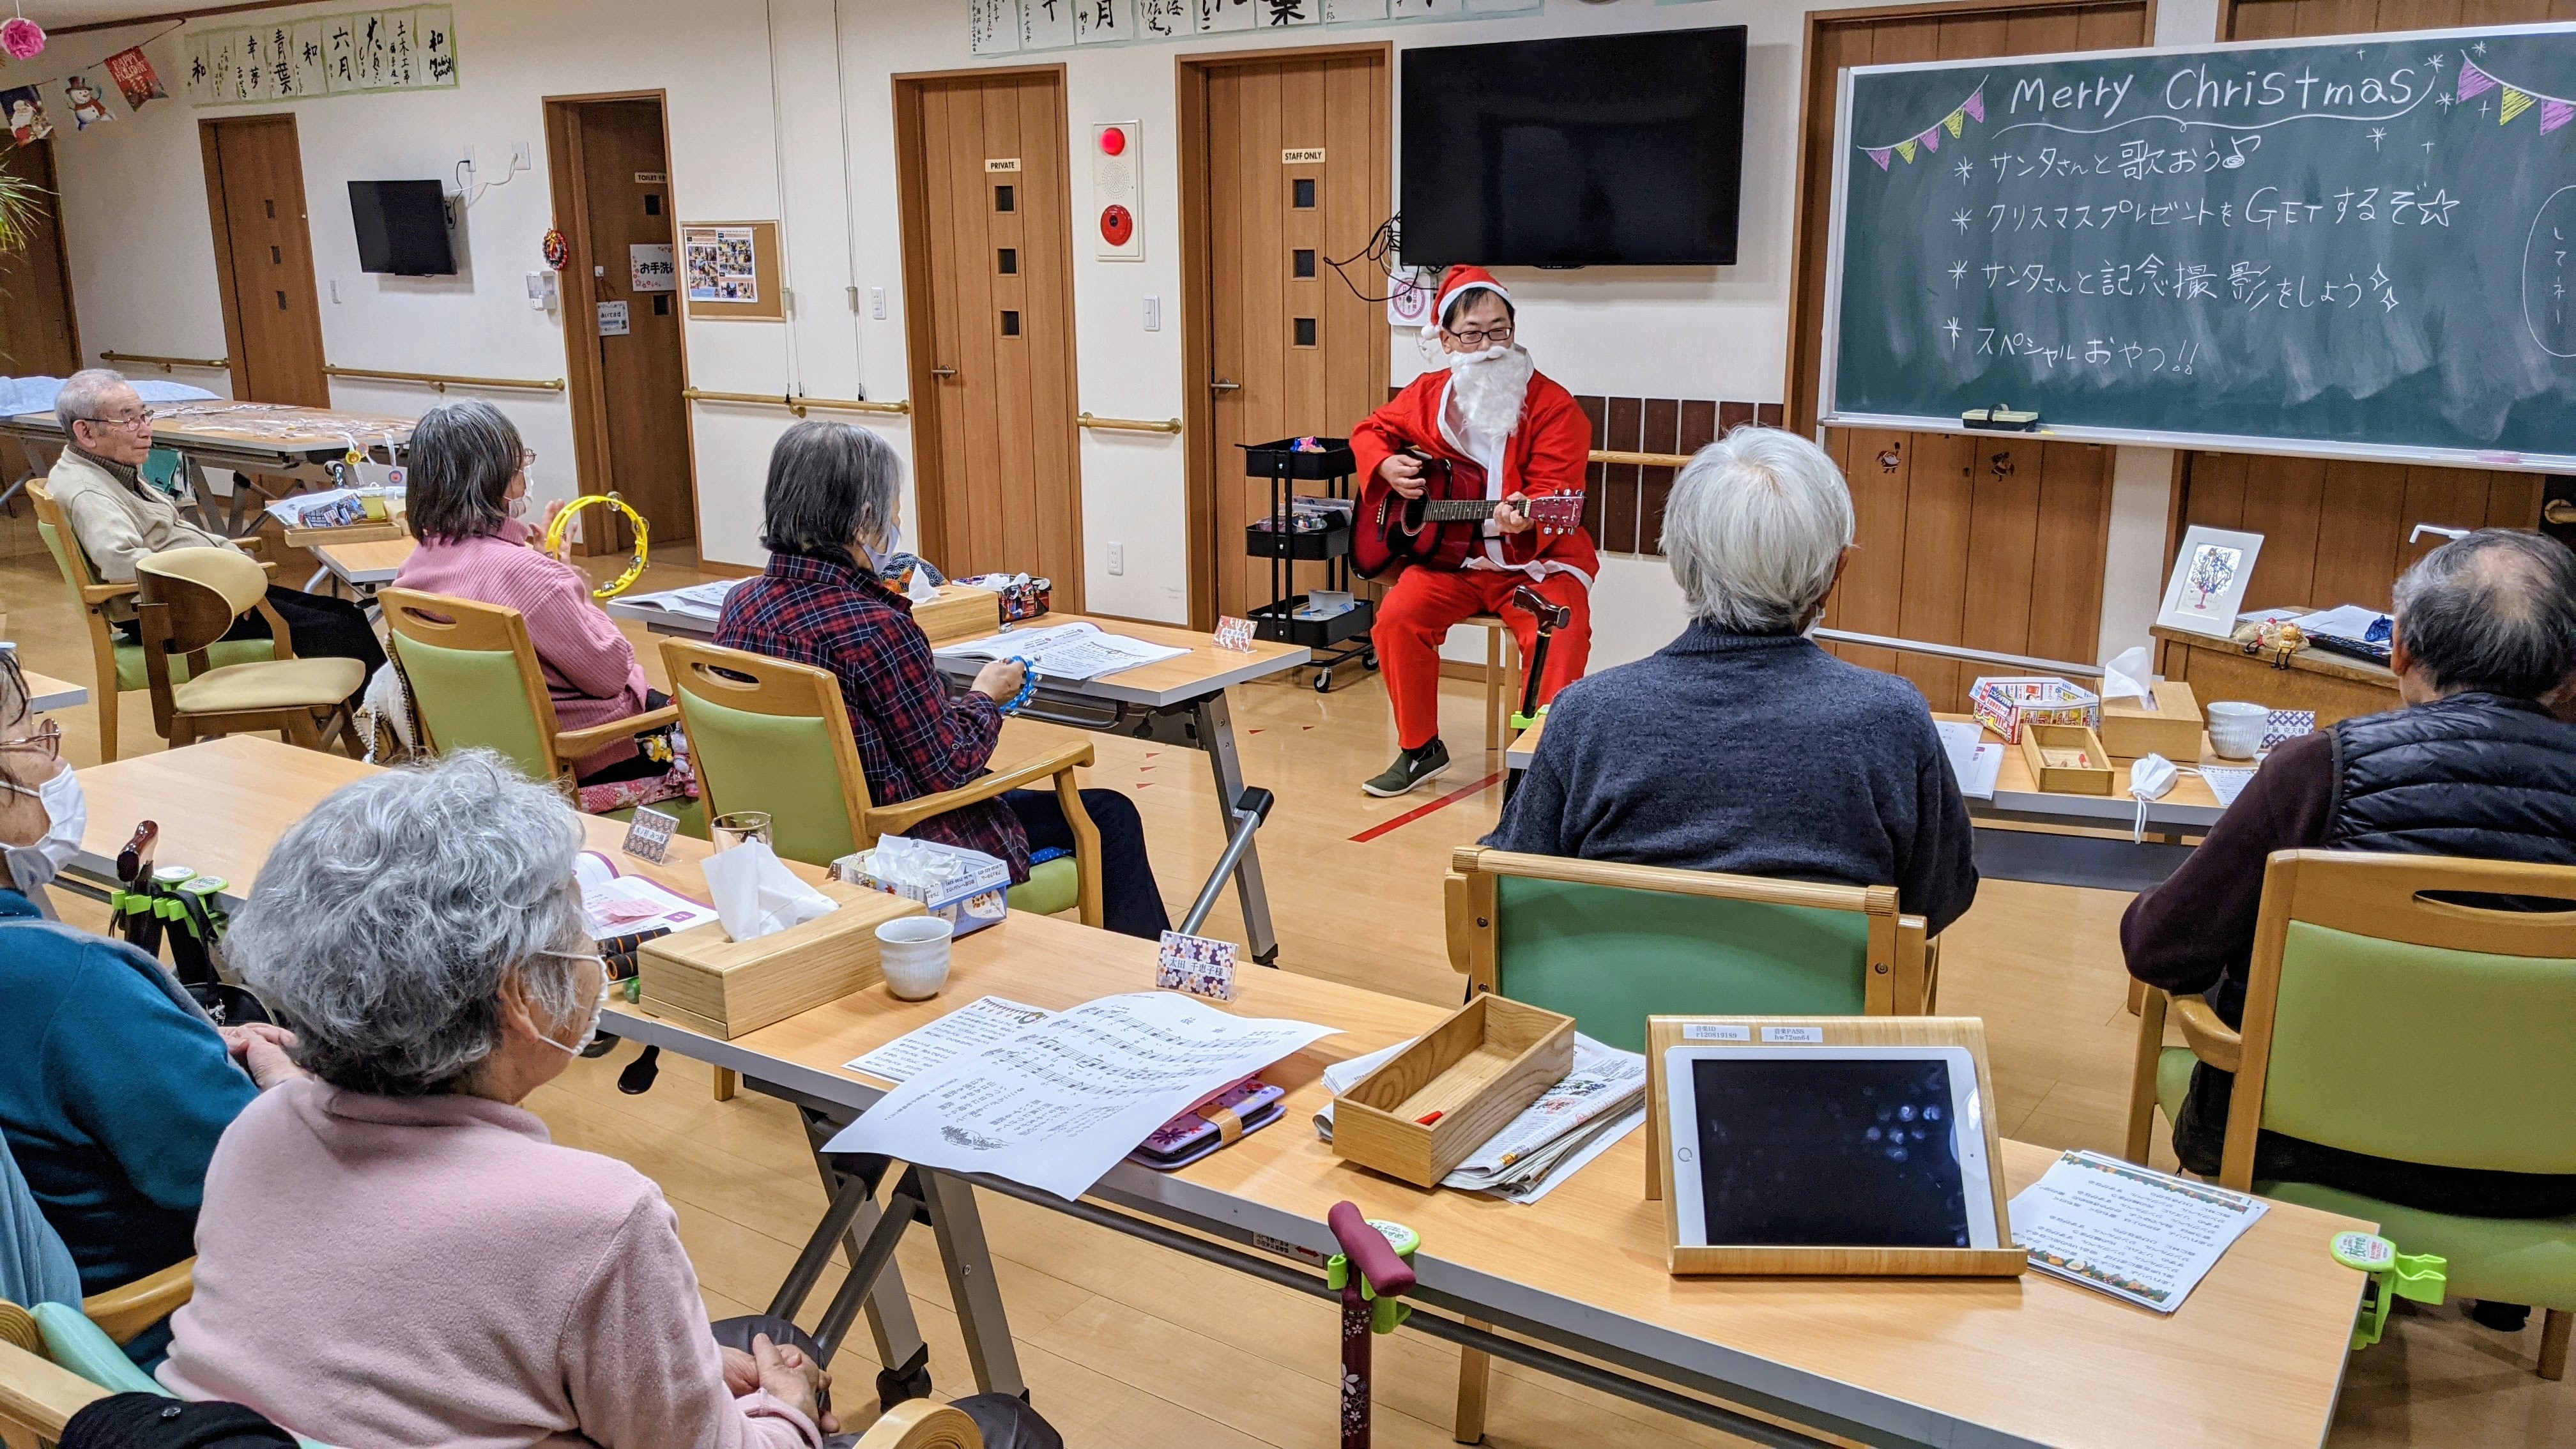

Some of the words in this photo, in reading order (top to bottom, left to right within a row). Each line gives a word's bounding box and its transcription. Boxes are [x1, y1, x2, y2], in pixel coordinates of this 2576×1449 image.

[2010, 74, 2134, 119] Merry
[2166, 63, 2415, 111] Christmas
[990, 161, 1015, 170] PRIVATE
[1285, 152, 1303, 161] STAFF
[1304, 151, 1322, 161] ONLY
[1989, 138, 2221, 184] サンタさんと歌おう
[1981, 253, 2362, 312] サンタさんと記念撮影をしよう
[1169, 958, 1186, 969] 太田
[1190, 963, 1223, 977] 千恵子様
